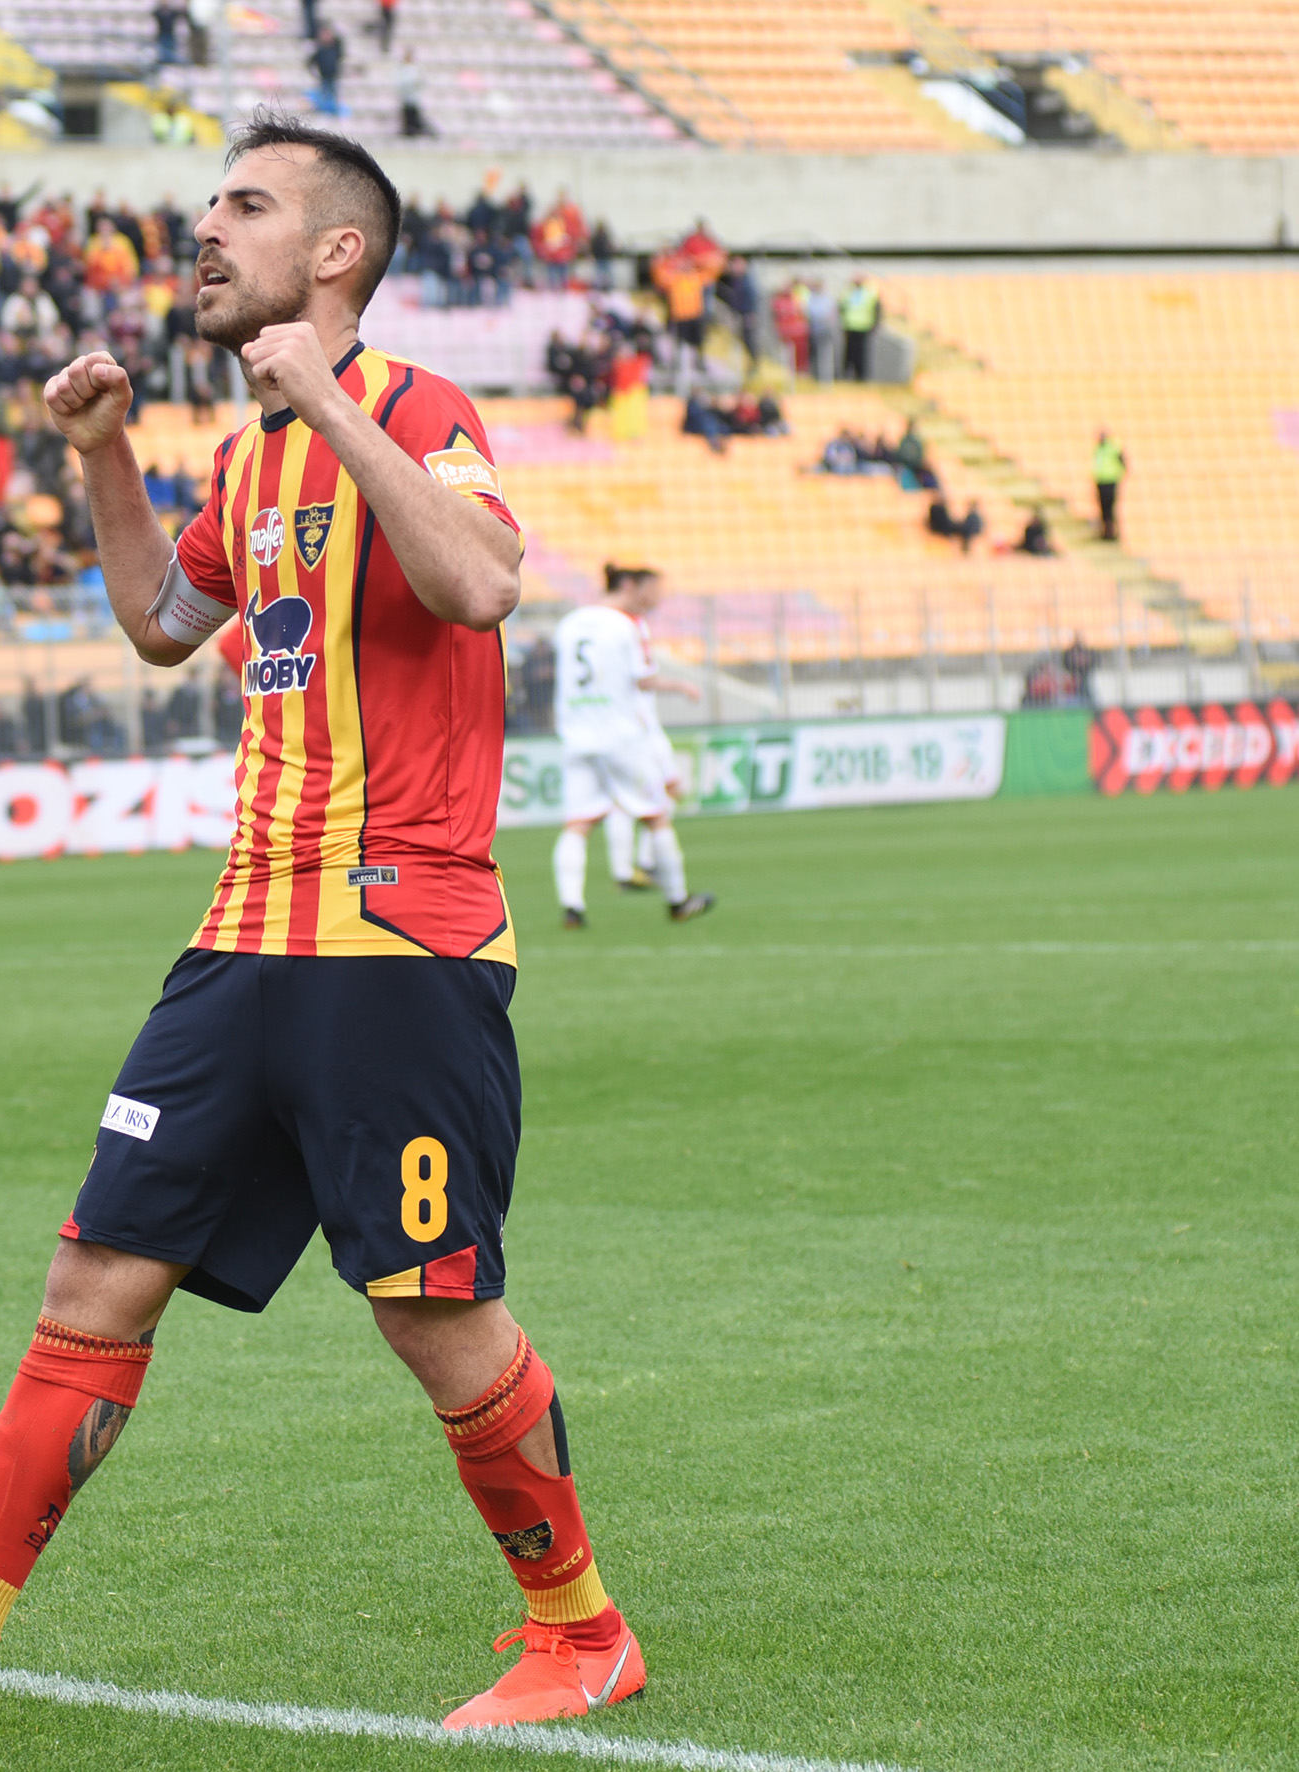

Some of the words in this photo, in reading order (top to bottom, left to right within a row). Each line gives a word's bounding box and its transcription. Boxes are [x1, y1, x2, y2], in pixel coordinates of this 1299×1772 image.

[300, 512, 327, 524] LECCE
[171, 609, 192, 627] SALUTE
[176, 594, 210, 619] GIORNATA
[176, 603, 194, 620] DELLA
[195, 616, 216, 628] TUTELA
[246, 654, 316, 696] MOBY
[576, 638, 594, 688] 5
[1123, 720, 1272, 776] EXCEED
[357, 874, 377, 882] LECCE
[124, 1108, 152, 1130] IRIS
[401, 1136, 449, 1243] 8
[541, 1546, 585, 1580] LECCE
